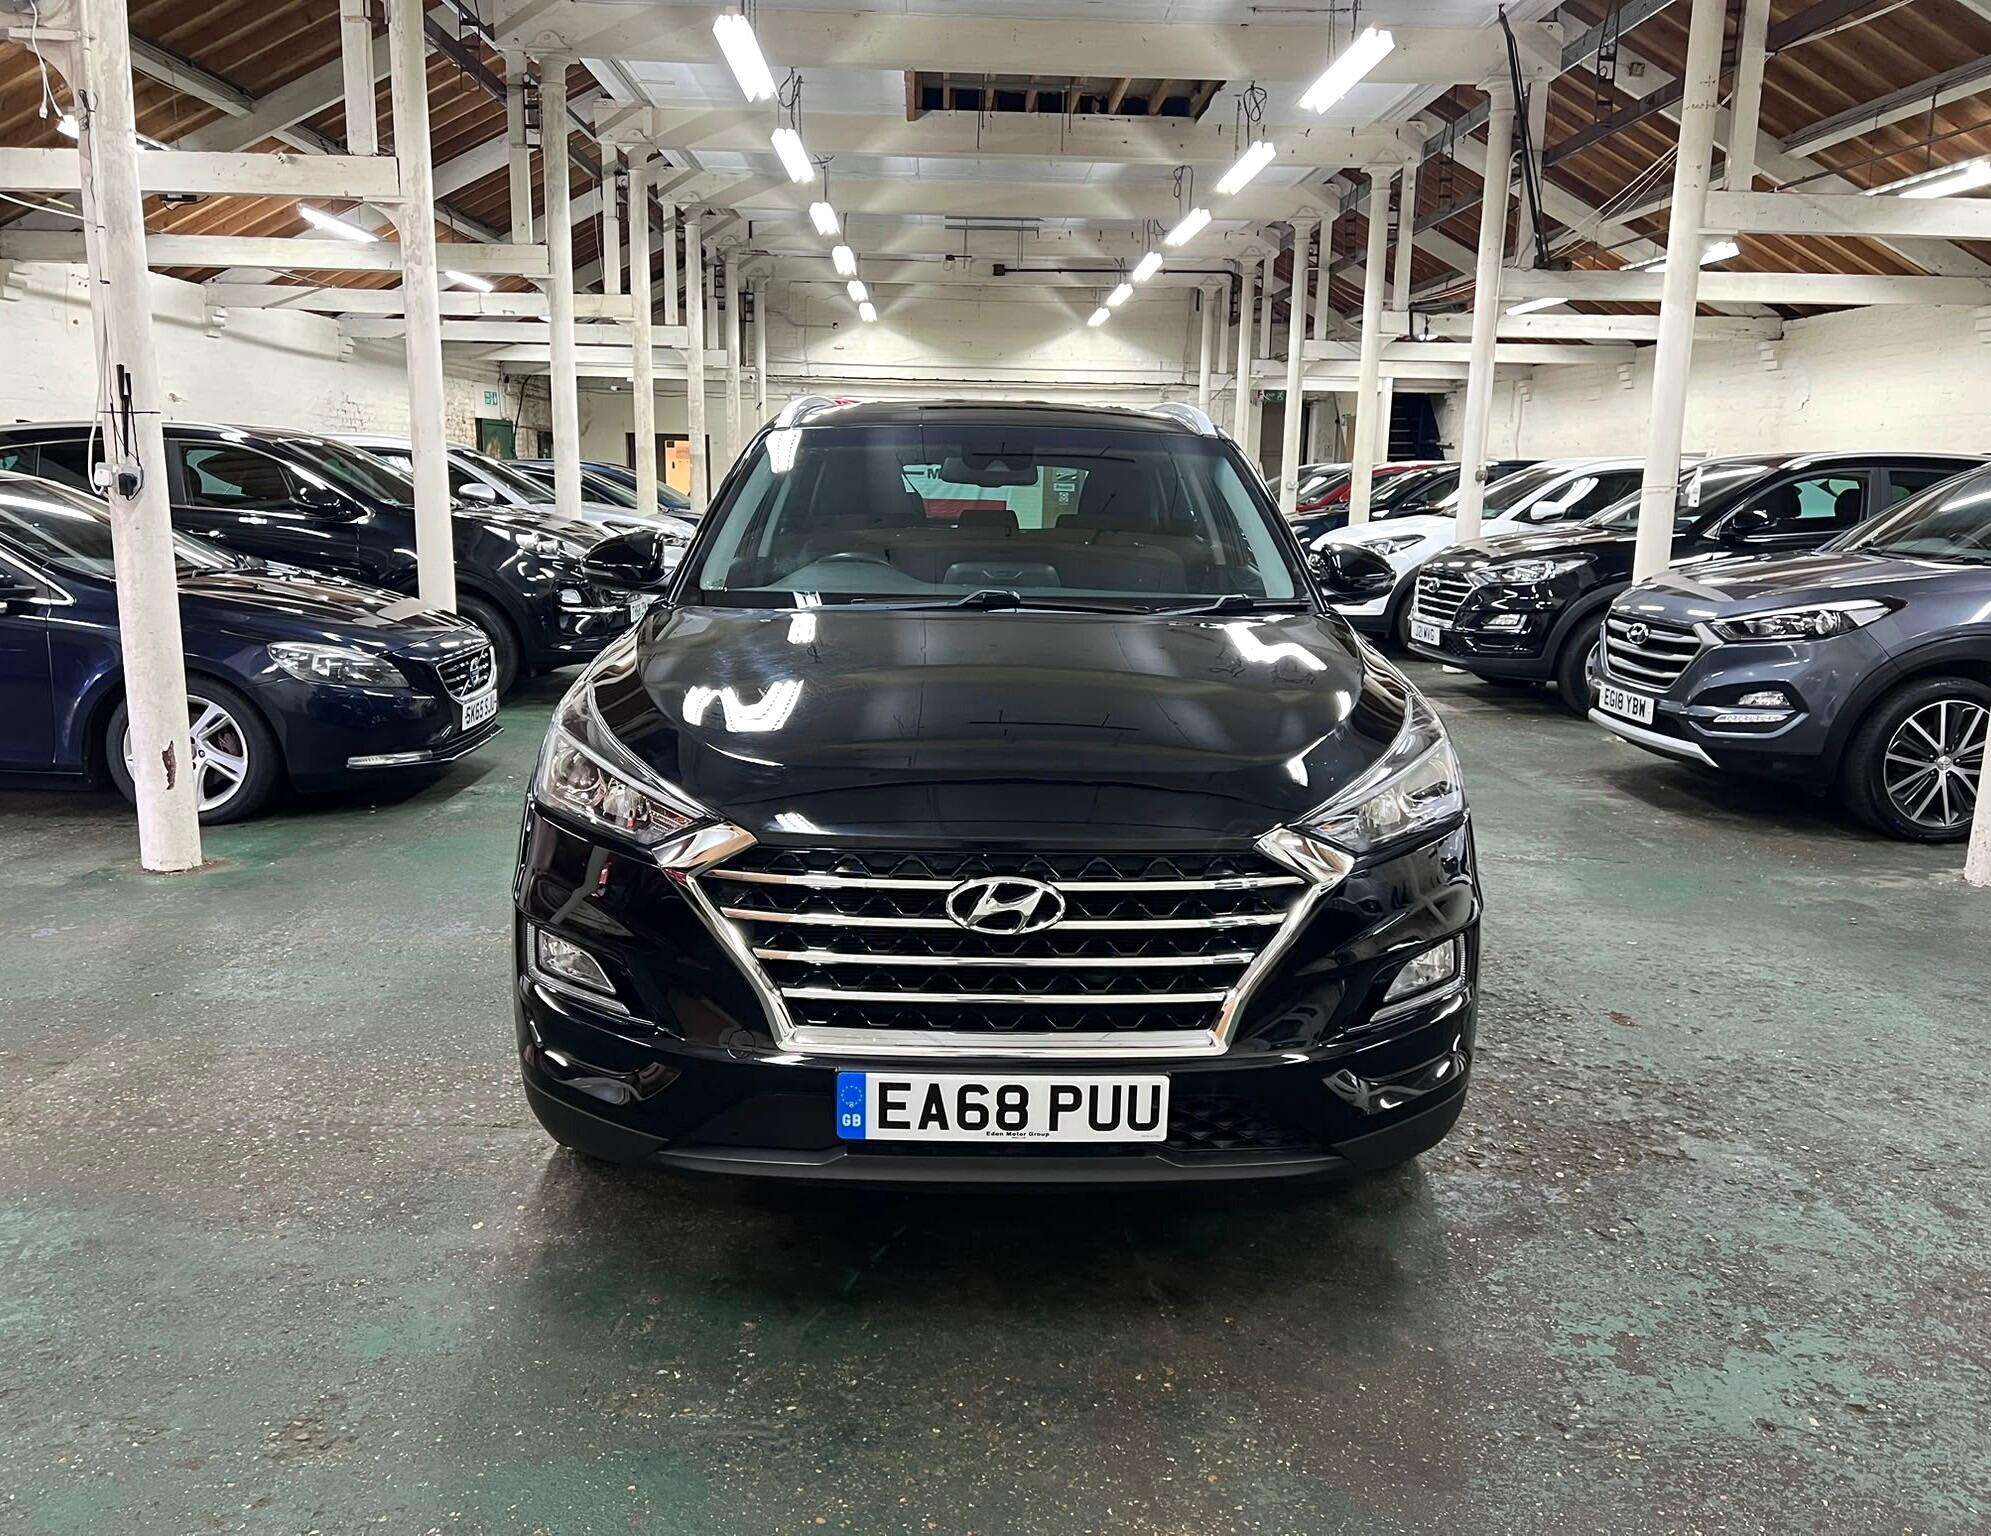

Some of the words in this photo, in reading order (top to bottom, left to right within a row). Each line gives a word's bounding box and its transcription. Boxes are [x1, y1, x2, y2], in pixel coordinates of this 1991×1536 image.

[1604, 688, 1624, 710] EG18
[878, 1082, 1030, 1131] EA68
[1049, 1084, 1161, 1132] PUU
[842, 1113, 862, 1127] GB
